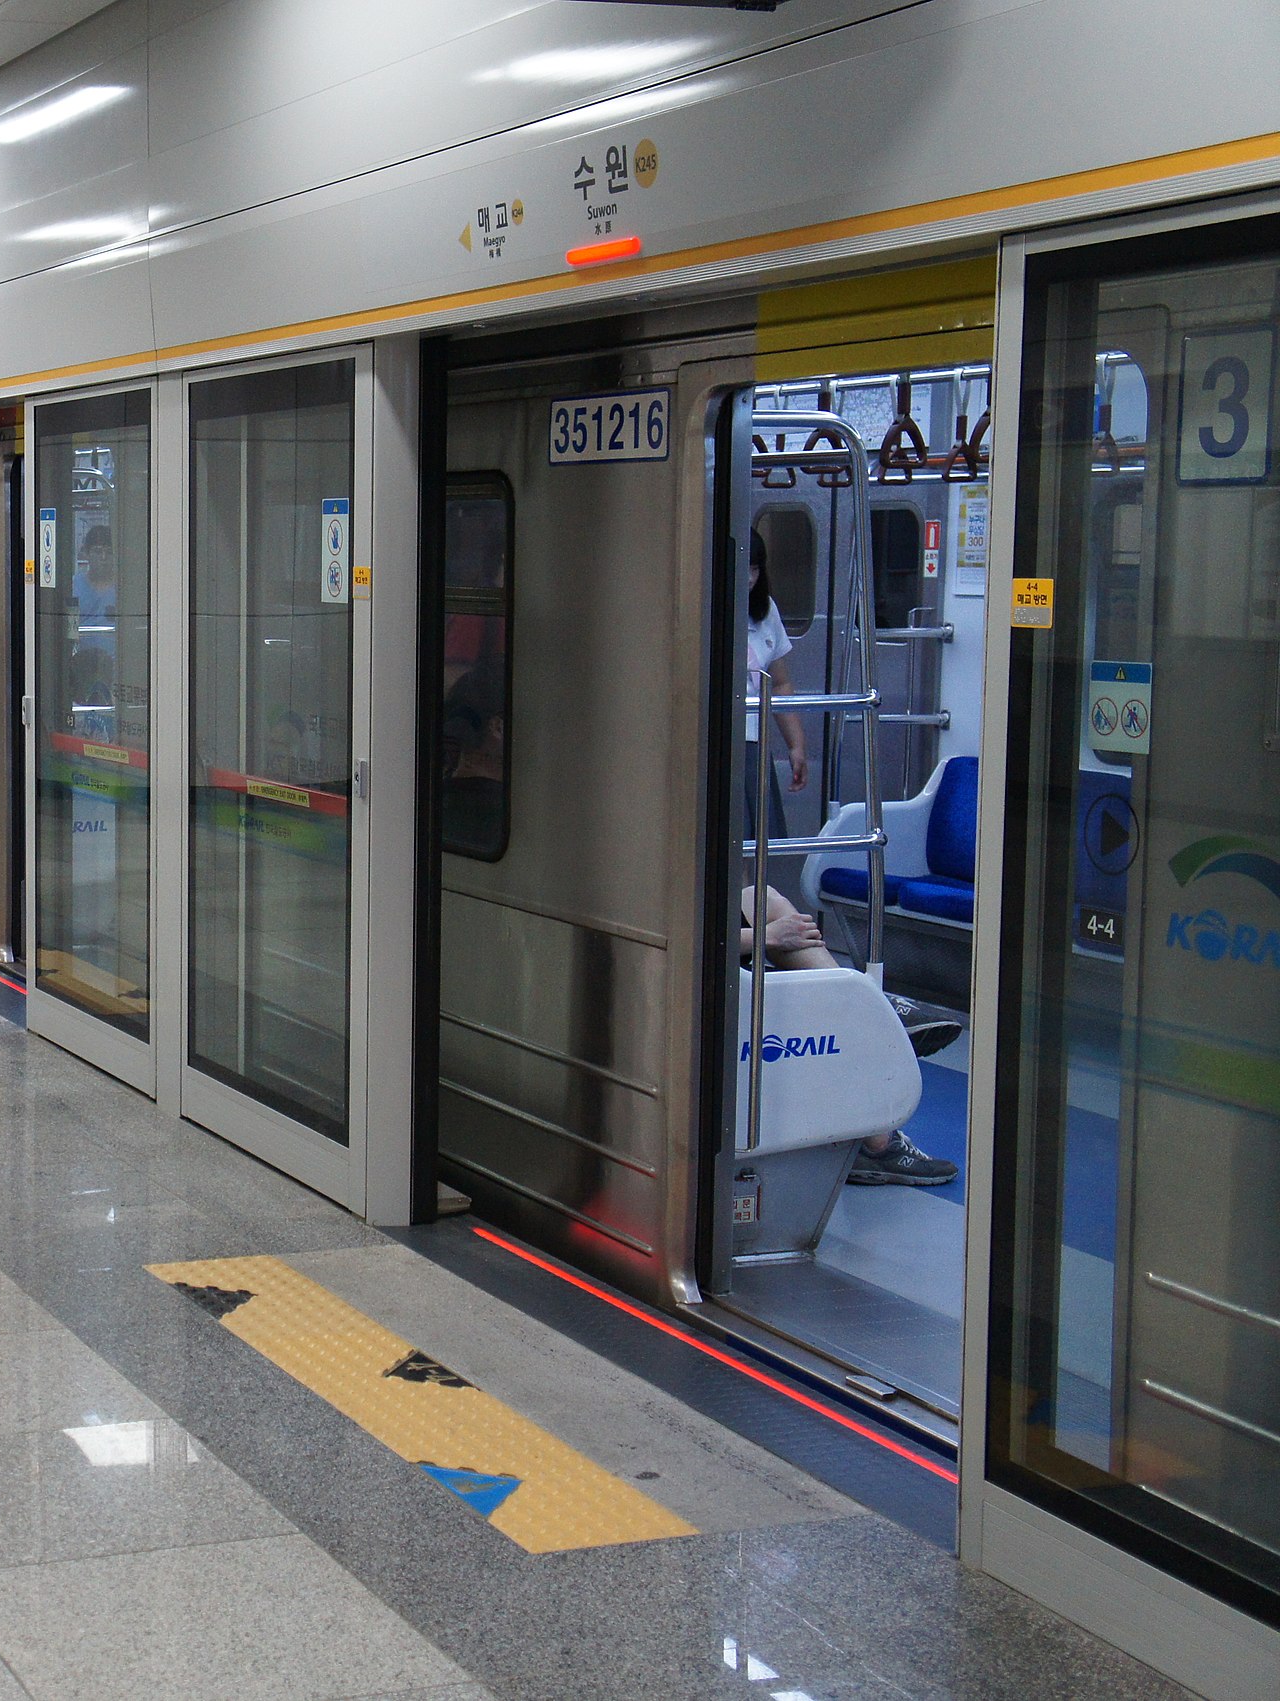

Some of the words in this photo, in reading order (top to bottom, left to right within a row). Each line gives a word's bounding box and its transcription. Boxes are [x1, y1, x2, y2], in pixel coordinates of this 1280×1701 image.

[574, 145, 629, 200] 수원
[635, 155, 657, 173] K245
[478, 202, 508, 233] 매교
[587, 203, 618, 220] Suwon
[483, 236, 506, 247] Maegyo
[1199, 356, 1250, 459] 3
[554, 399, 665, 454] 351216
[1026, 582, 1038, 591] 4-4
[1033, 594, 1047, 605] 방면
[1087, 915, 1115, 938] 4-4
